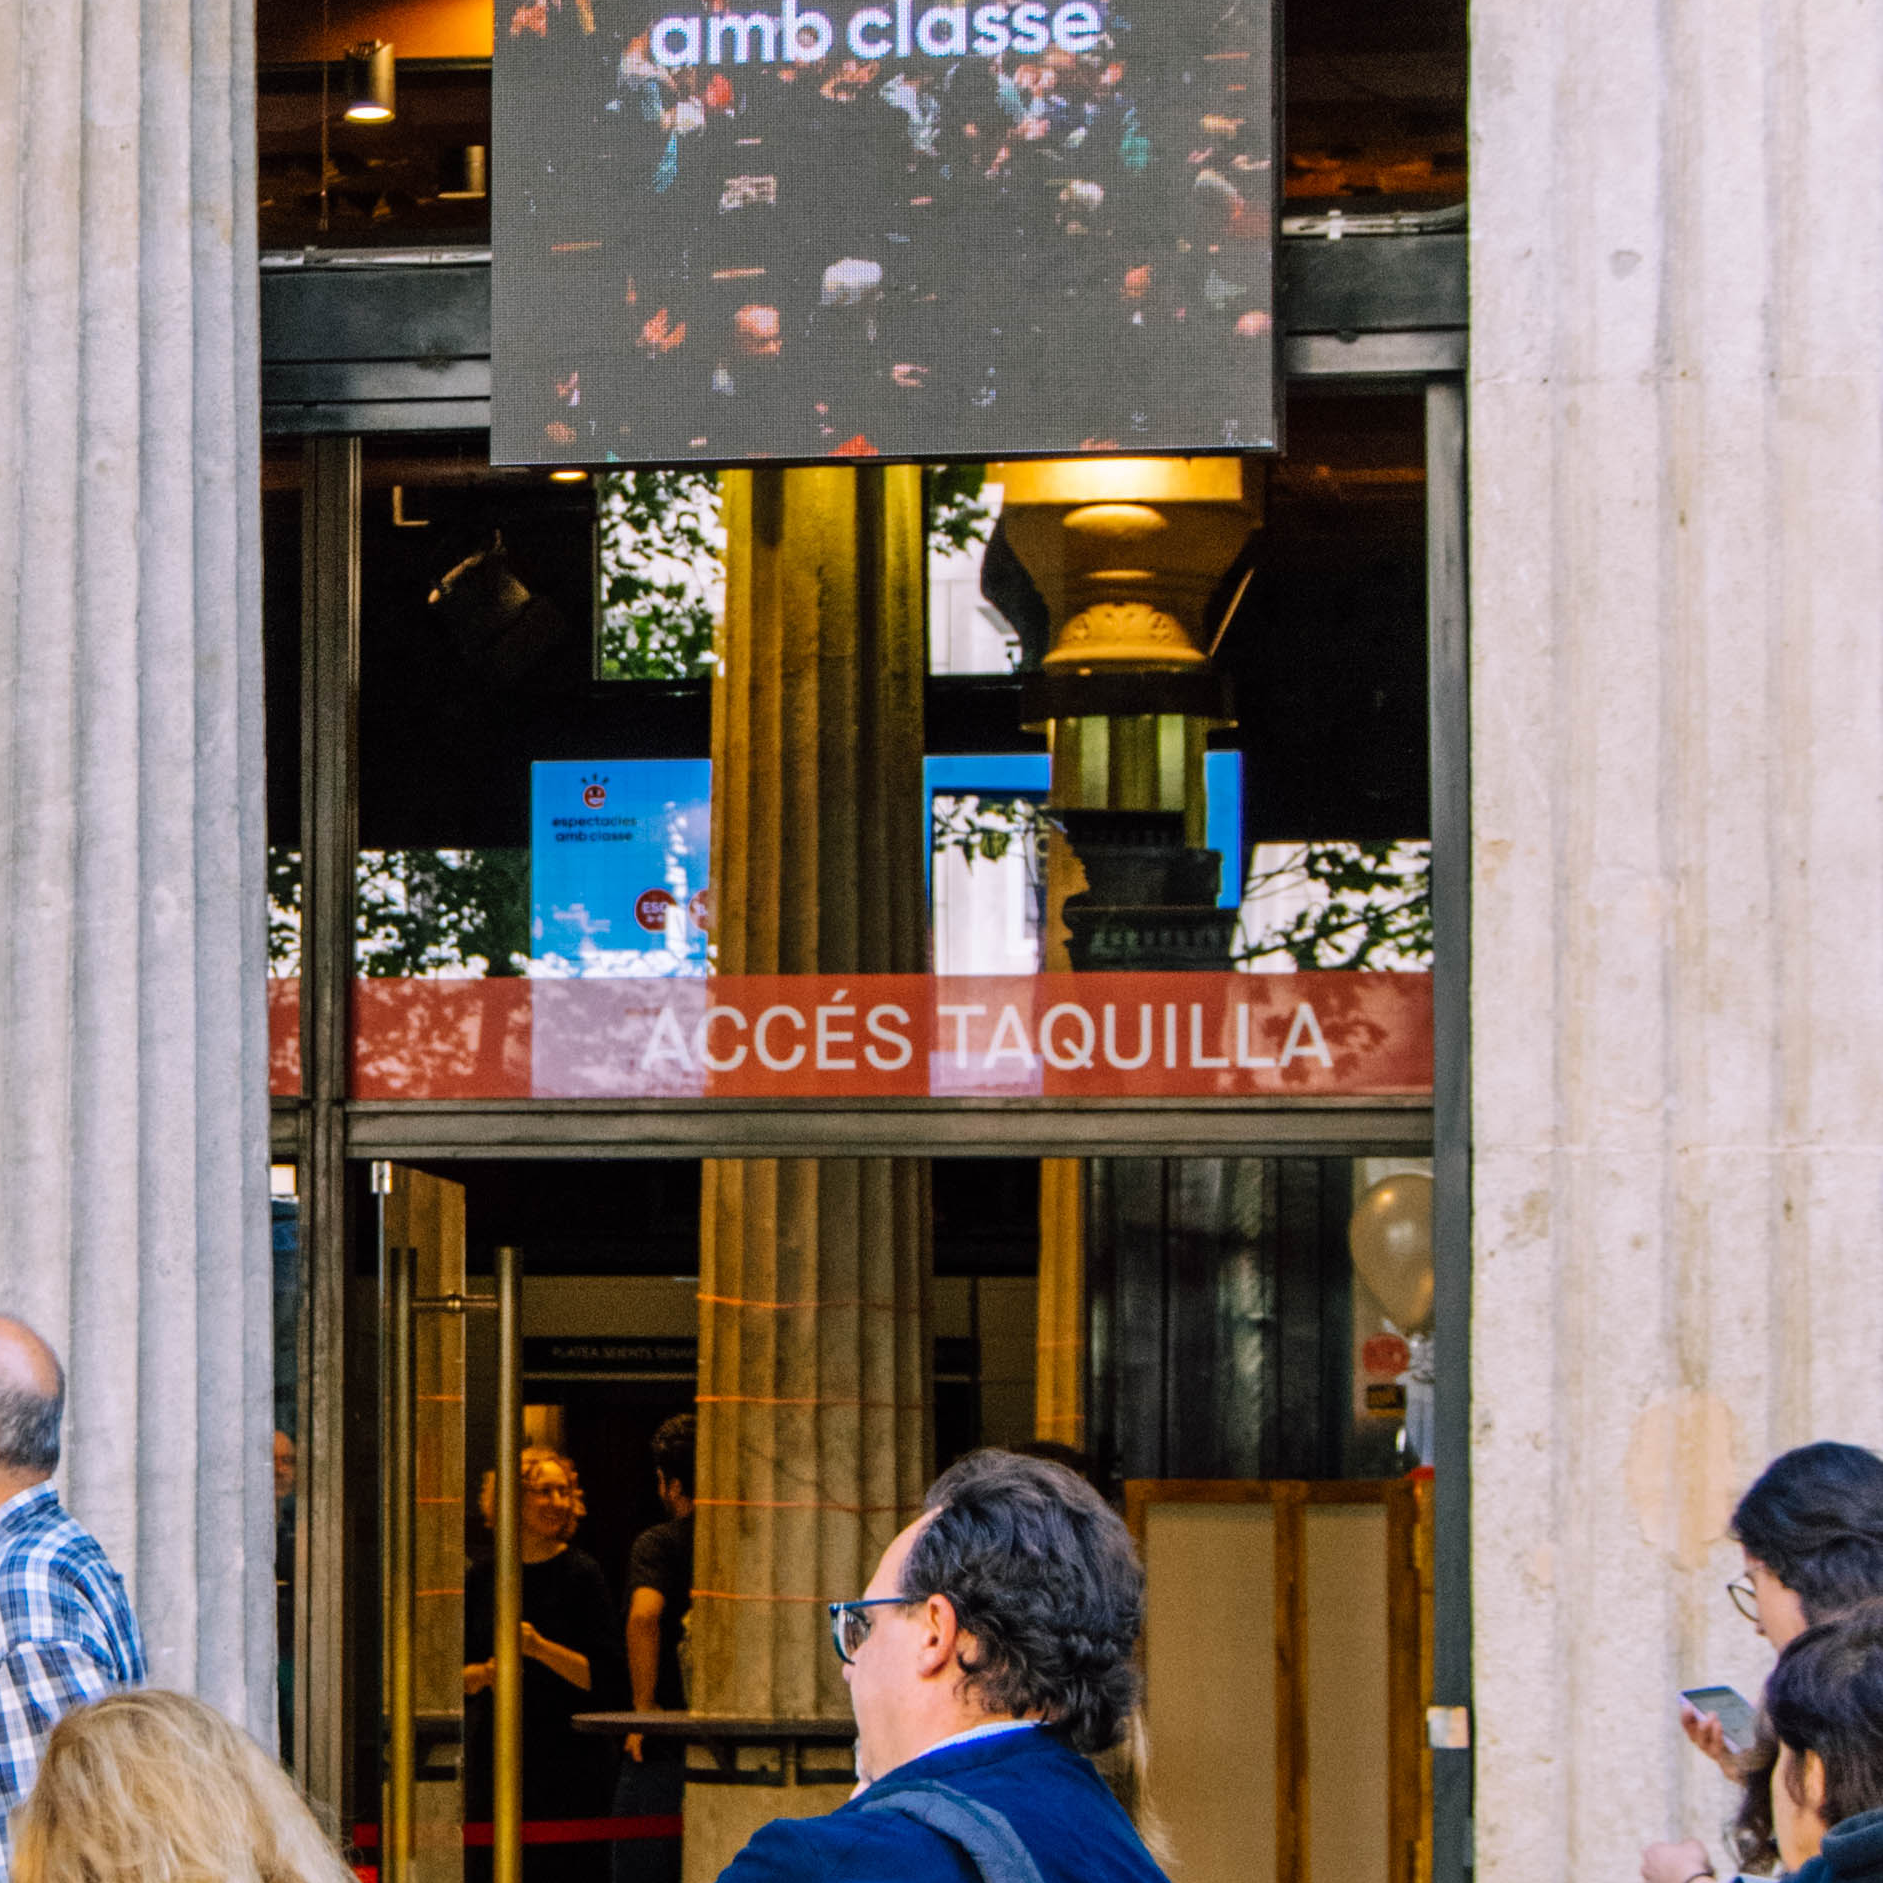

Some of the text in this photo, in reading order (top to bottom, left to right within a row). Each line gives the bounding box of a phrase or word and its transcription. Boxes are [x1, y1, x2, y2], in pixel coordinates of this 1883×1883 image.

[552, 814, 638, 829] espectacles
[555, 831, 634, 843] amb classe
[639, 989, 1336, 1075] ACCÉS TAQUILLA
